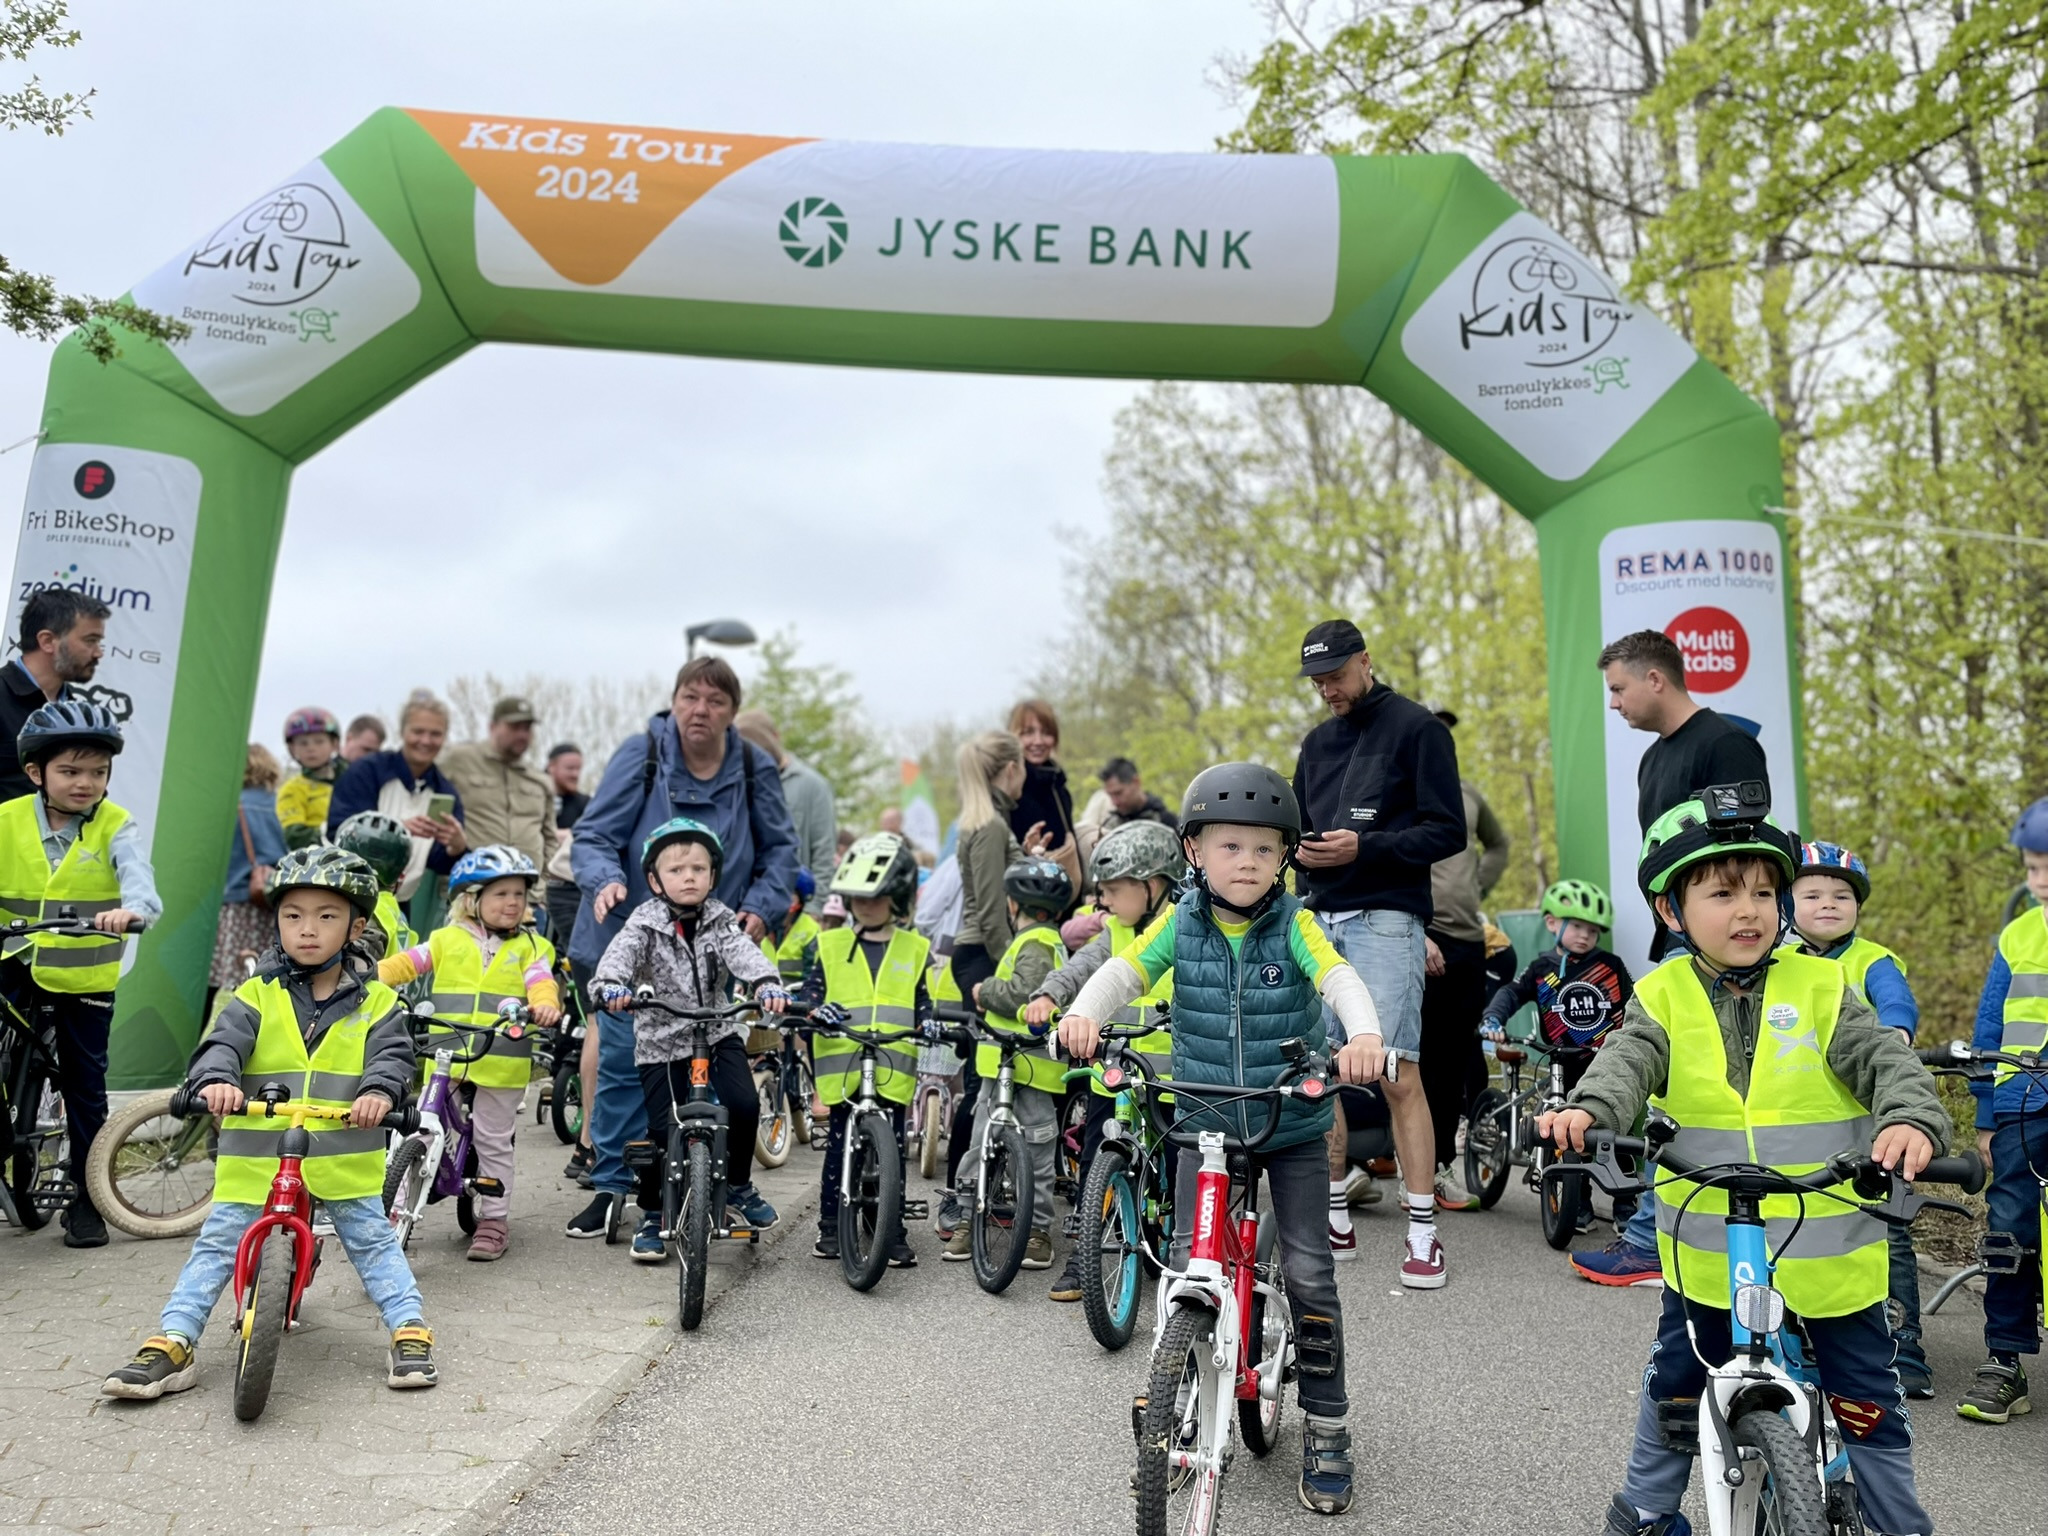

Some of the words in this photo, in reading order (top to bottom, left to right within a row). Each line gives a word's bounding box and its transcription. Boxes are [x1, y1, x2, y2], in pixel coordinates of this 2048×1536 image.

[459, 121, 588, 157] Kids
[606, 131, 732, 167] Tour
[535, 165, 640, 203] 2024
[877, 217, 1060, 263] JYSKE
[1089, 225, 1252, 270] BANK
[184, 233, 284, 277] Kids
[283, 234, 361, 289] Tour
[247, 280, 276, 293] 2024
[181, 306, 297, 335] Børneulykkes
[1459, 291, 1567, 350] Kids
[1561, 292, 1634, 344] Tour
[206, 325, 267, 346] fonden
[1538, 343, 1567, 353] 2024
[1478, 376, 1592, 398] Børneulykkes
[1504, 395, 1564, 411] fonden
[27, 510, 48, 531] Fri
[54, 509, 175, 546] BikeShop
[46, 533, 70, 543] OPLEV
[71, 535, 131, 549] FORSKELLEN
[1617, 551, 1709, 577] REMA
[1720, 550, 1774, 575] 1000
[1615, 577, 1683, 596] Discount
[1687, 575, 1721, 588] med
[1724, 575, 1775, 594] holdning
[1675, 629, 1736, 652] Multi
[1683, 652, 1737, 673] tabs
[1570, 1009, 1595, 1017] CYKLER
[1199, 1186, 1217, 1240] woom
